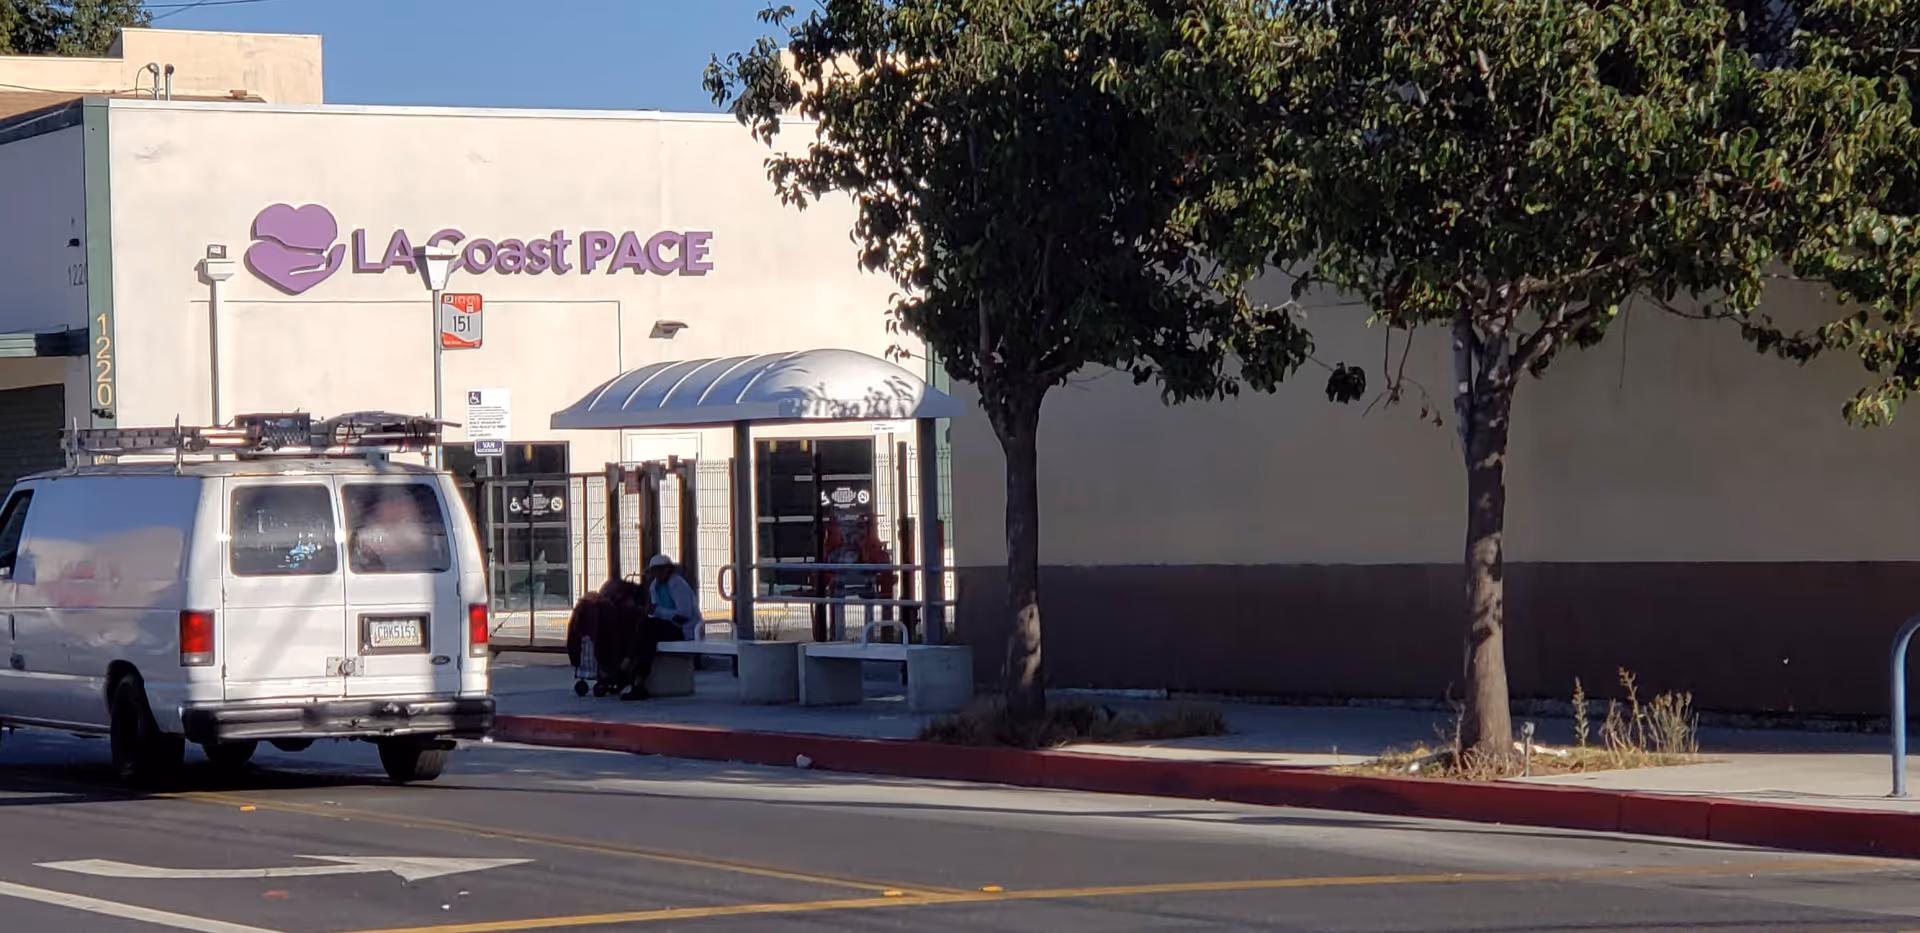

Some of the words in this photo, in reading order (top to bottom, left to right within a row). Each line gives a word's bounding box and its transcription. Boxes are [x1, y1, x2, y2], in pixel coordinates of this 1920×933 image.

[351, 228, 417, 274] LA
[579, 230, 714, 276] PACE
[453, 315, 471, 332] 151
[96, 313, 113, 406] 1220
